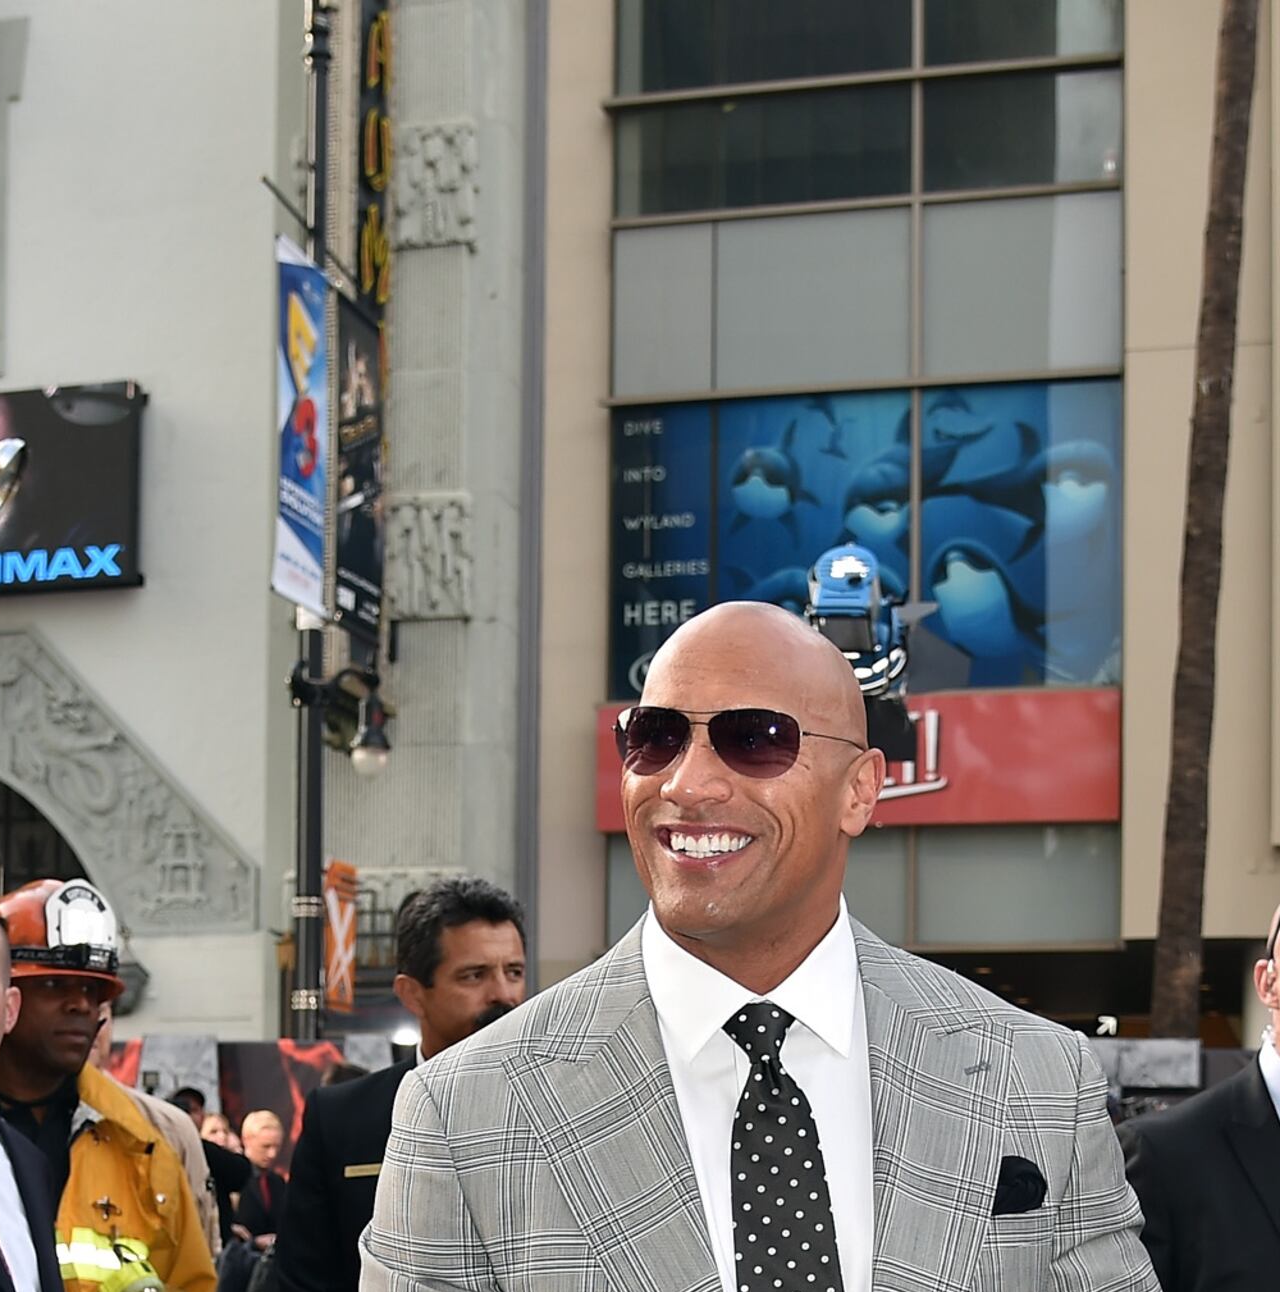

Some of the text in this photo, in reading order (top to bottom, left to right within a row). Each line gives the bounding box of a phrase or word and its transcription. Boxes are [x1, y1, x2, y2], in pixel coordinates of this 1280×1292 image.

[623, 419, 663, 437] DIVE
[623, 465, 667, 484] INTO
[622, 512, 696, 531] WYLAND
[622, 558, 710, 579] GALLERIES
[623, 600, 697, 627] HERE
